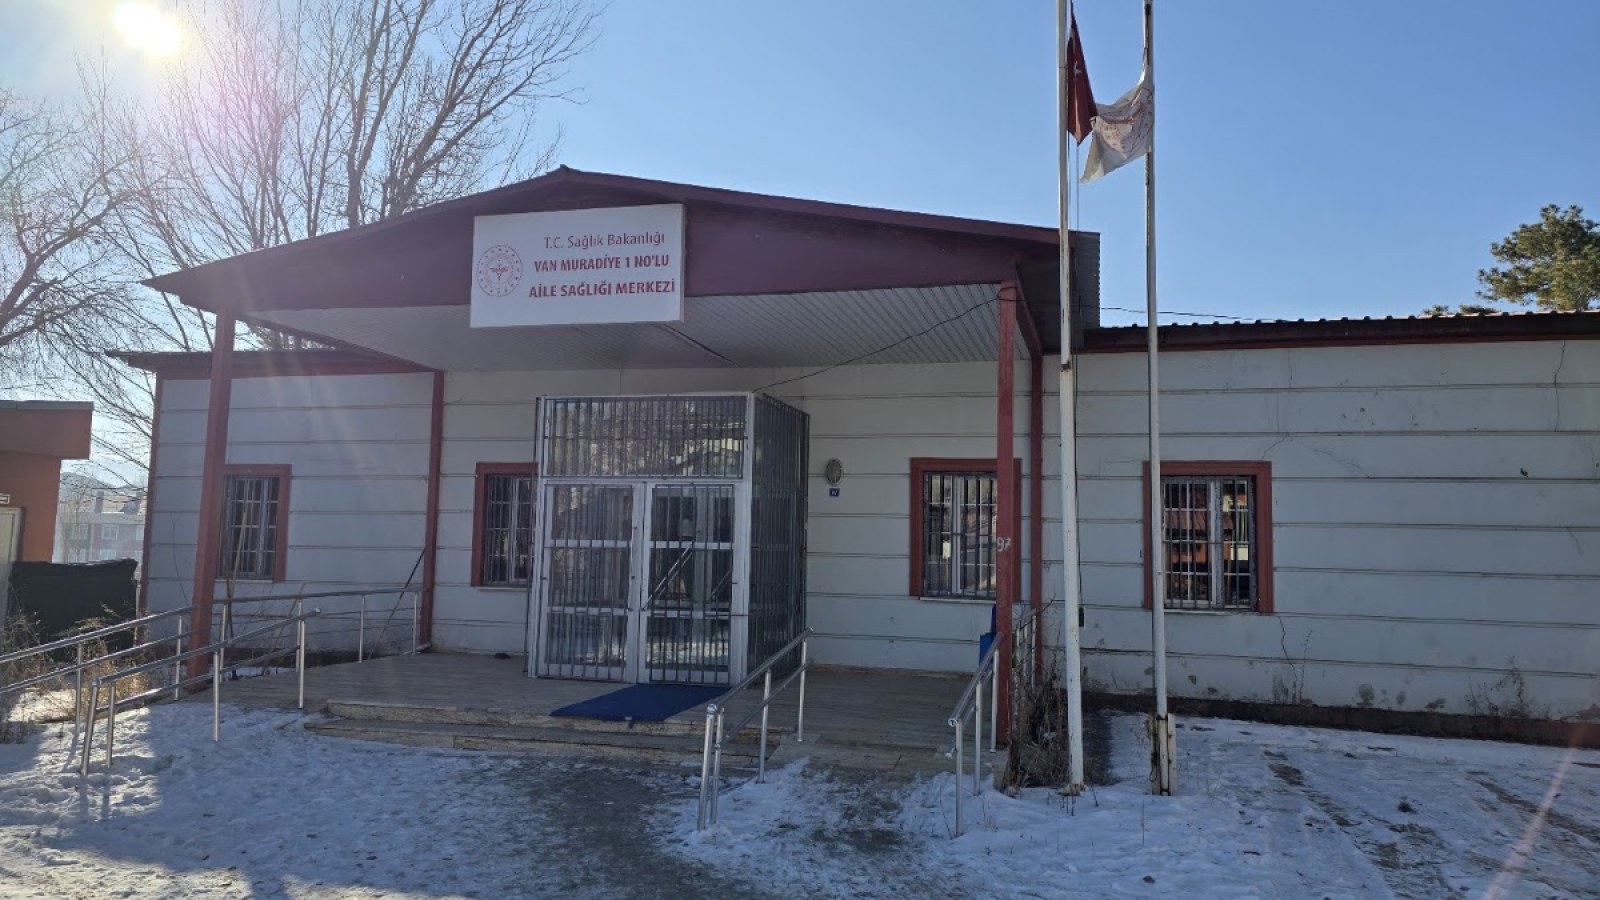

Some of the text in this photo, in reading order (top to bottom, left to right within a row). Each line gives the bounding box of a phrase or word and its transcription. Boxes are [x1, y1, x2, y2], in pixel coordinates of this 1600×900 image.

[544, 231, 665, 250] T.C. Sağlık Bakanlığı
[534, 254, 669, 272] VAN MURADİYE 1 NO'LU
[529, 278, 675, 298] AİLE SAĞLIĞI MERKEZİ
[996, 537, 1012, 552] 97
